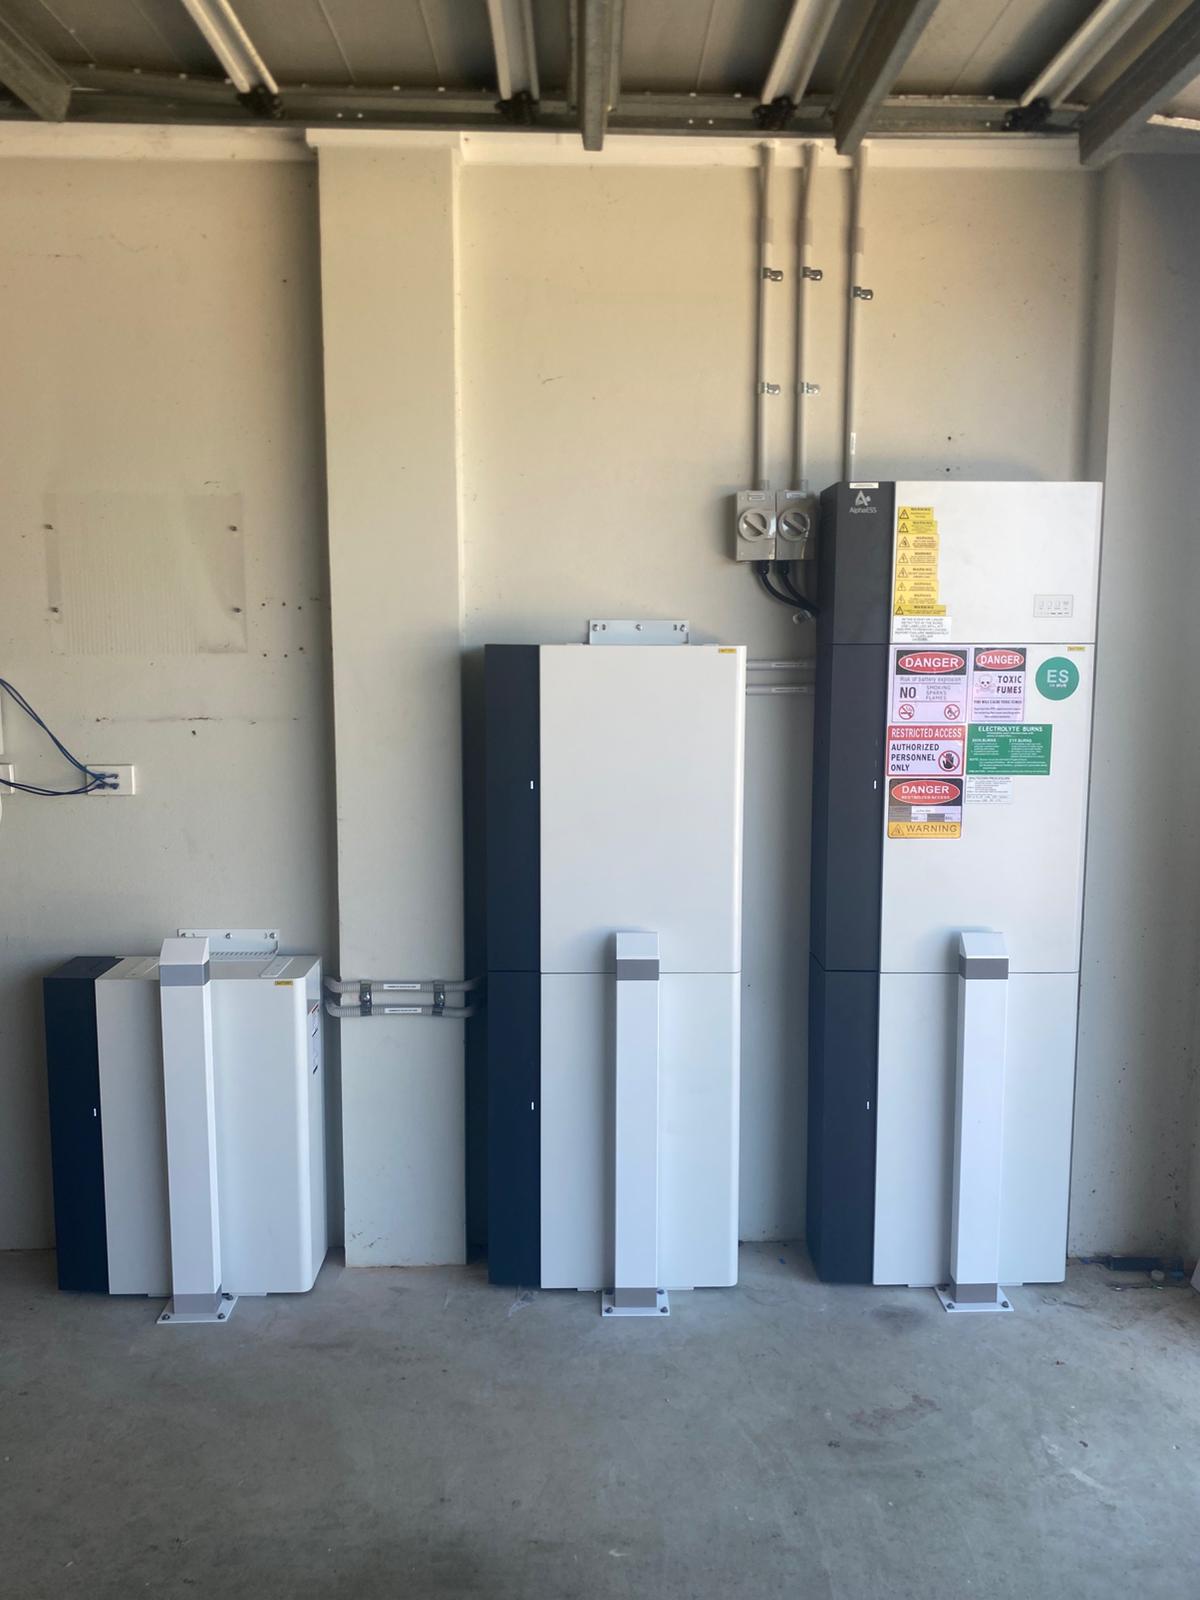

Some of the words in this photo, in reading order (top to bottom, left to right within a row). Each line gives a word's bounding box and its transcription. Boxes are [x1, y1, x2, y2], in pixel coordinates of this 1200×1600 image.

[905, 658, 958, 668] DANGER
[980, 655, 1020, 665] DANGER
[998, 675, 1022, 684] TOXIC
[1047, 669, 1069, 683] ES
[900, 686, 916, 699] NO
[996, 686, 1022, 694] FUMES
[892, 728, 934, 738] RESTRICTED
[935, 728, 962, 738] ACCESS
[891, 743, 939, 751] AUTHORIZED
[891, 753, 936, 761] PERSONNEL
[891, 763, 910, 772] ONLY
[902, 786, 949, 794] DANGER
[906, 824, 957, 833] WARNING
